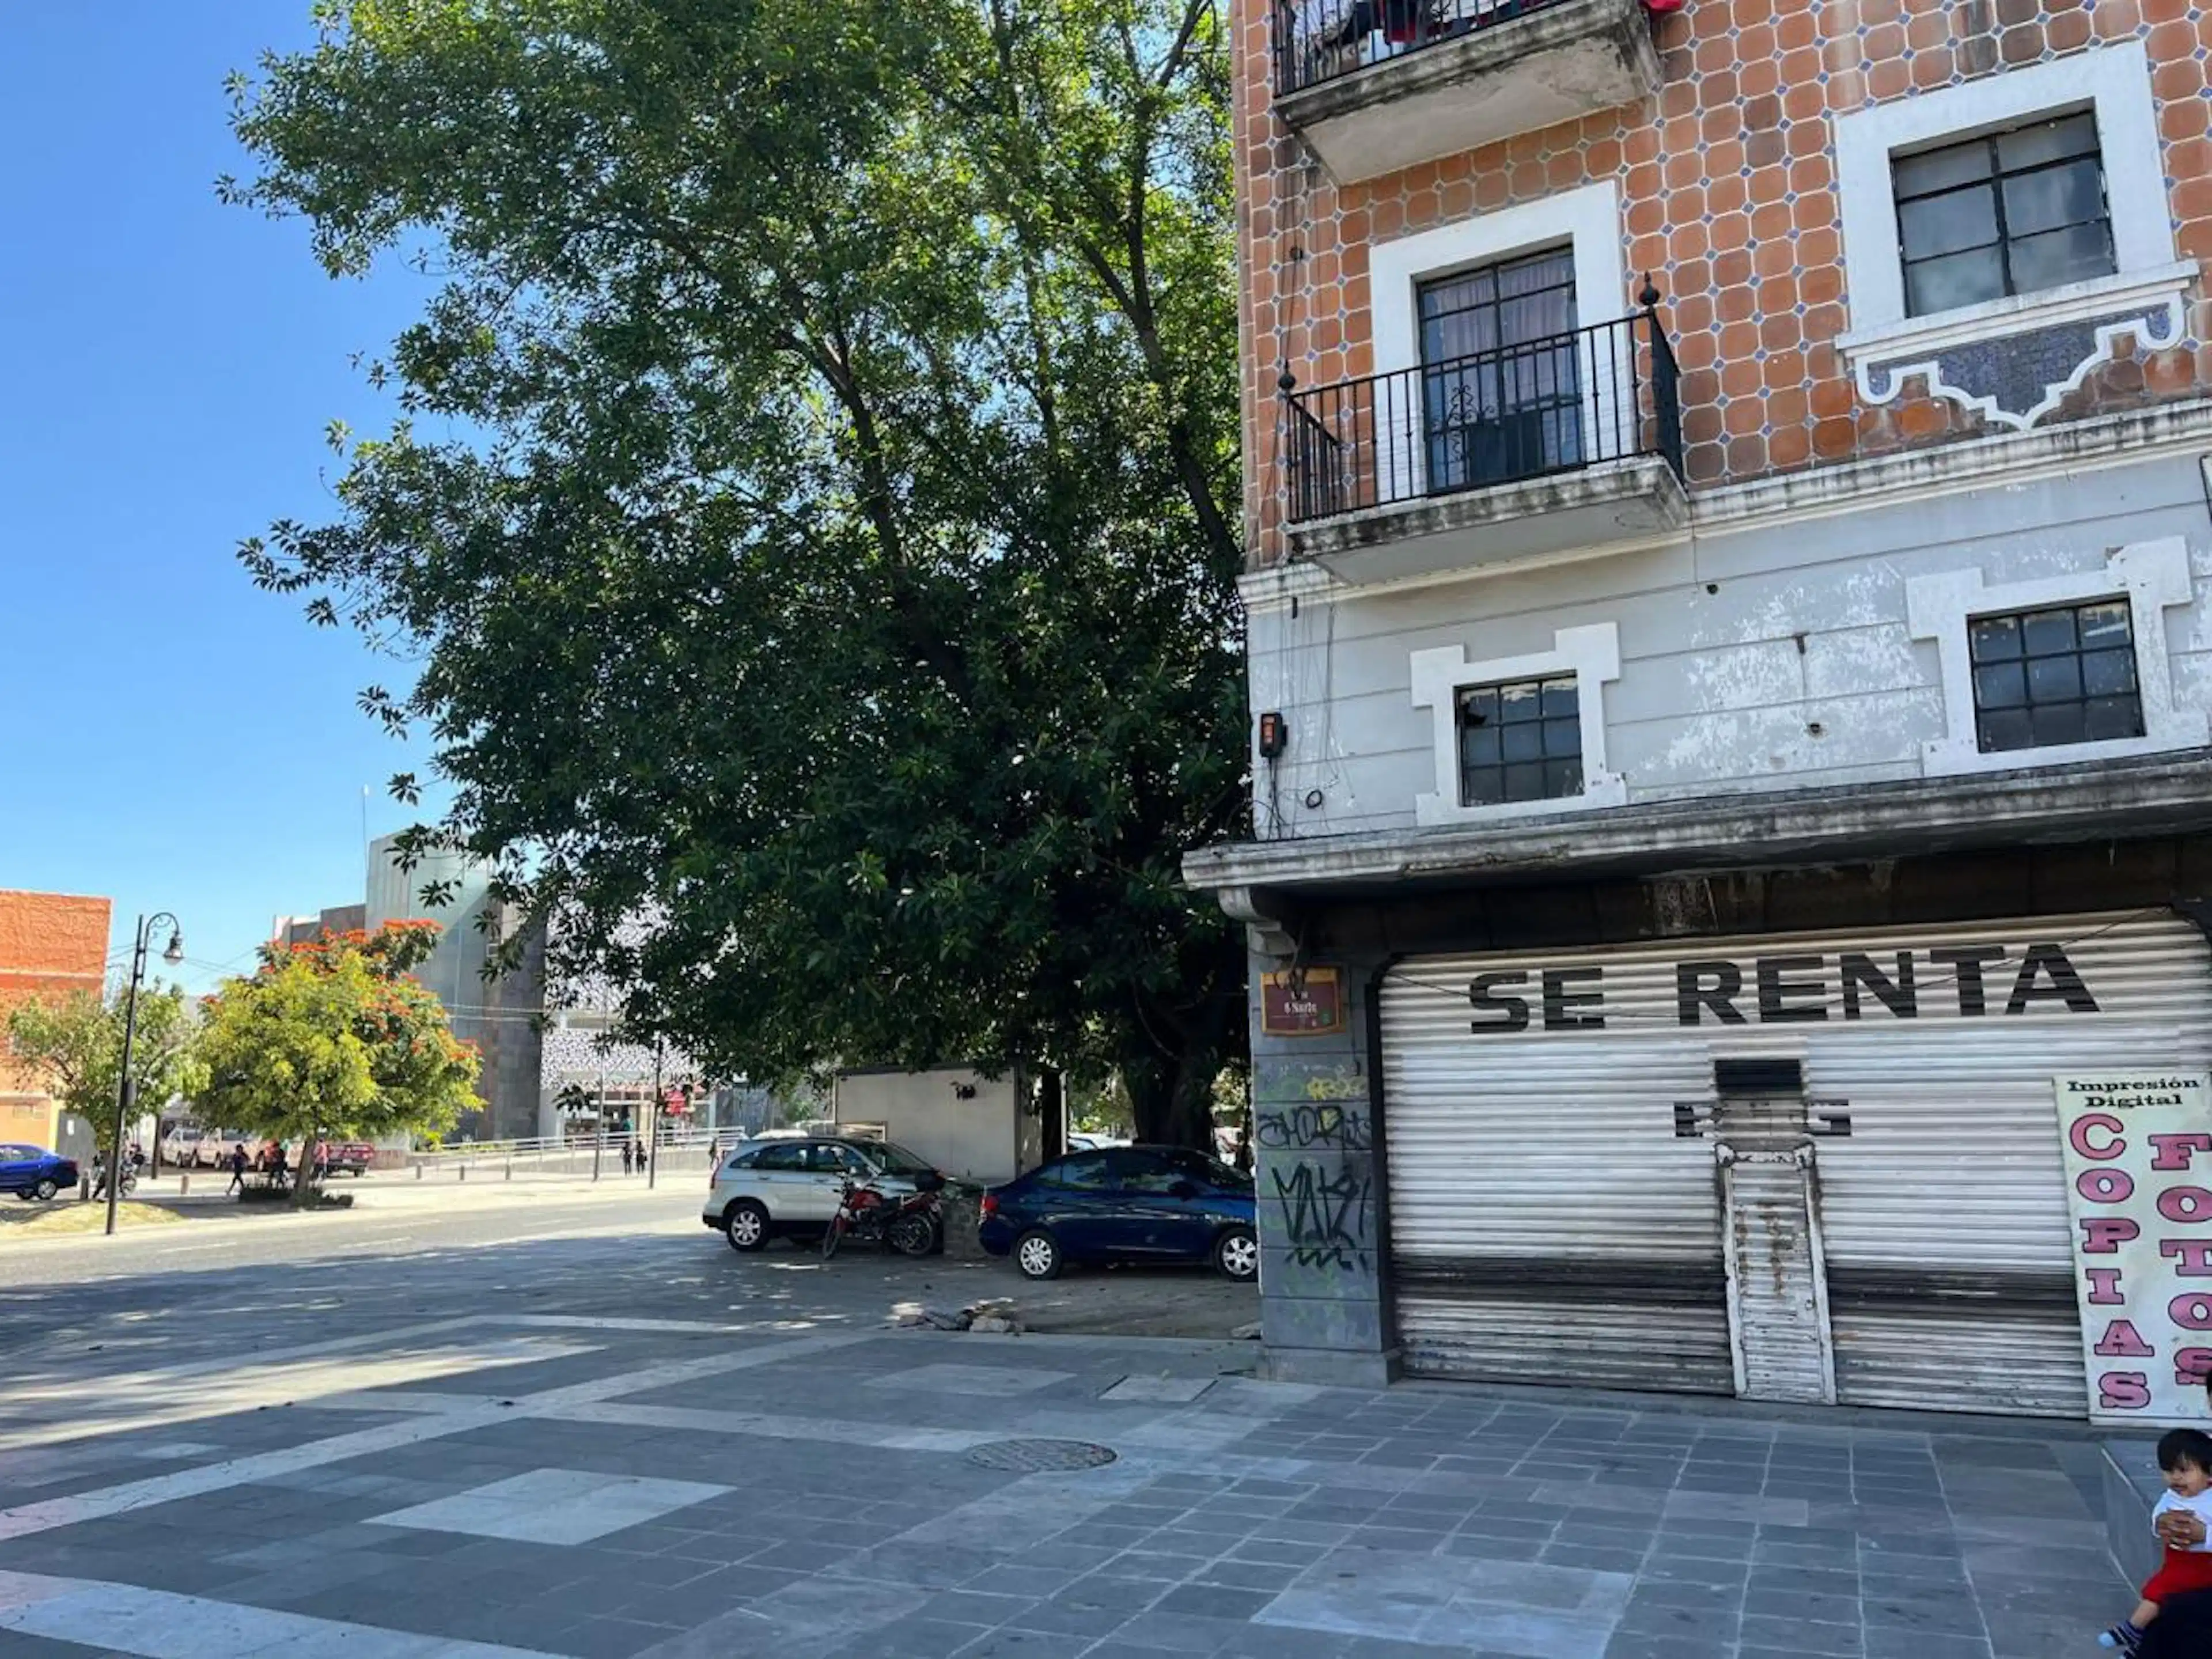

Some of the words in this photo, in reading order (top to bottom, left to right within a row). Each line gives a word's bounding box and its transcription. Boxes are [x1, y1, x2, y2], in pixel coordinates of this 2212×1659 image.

[1469, 967, 1606, 1034] SE
[1675, 943, 2102, 1027] RENTA
[2067, 1075, 2199, 1093] Impresión
[2085, 1094, 2183, 1108] Digital
[2070, 1113, 2155, 1408] COPIAS
